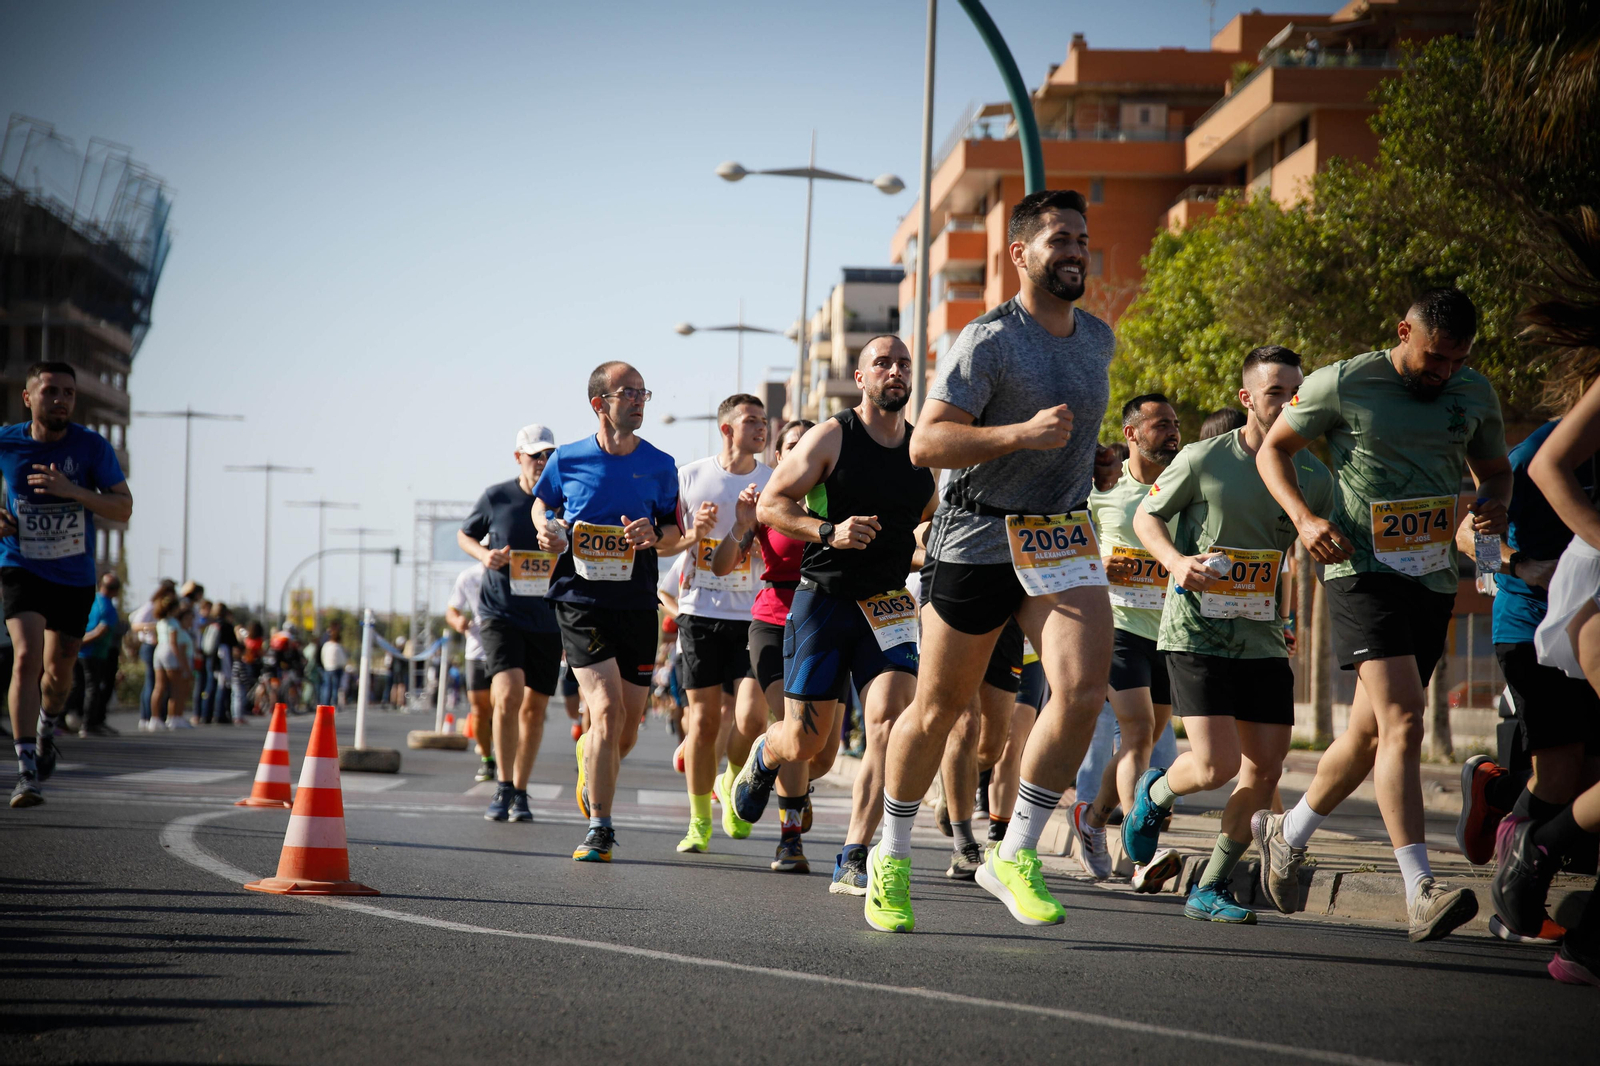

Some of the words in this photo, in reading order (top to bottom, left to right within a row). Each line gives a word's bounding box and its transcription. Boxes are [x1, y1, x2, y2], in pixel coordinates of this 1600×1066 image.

[26, 512, 78, 531] 5072
[1382, 508, 1448, 537] 2074
[579, 532, 630, 552] 2069
[1018, 525, 1088, 552] 2064
[1034, 548, 1077, 560] ALEXANDER
[520, 559, 550, 572] 455
[867, 595, 914, 616] 2063
